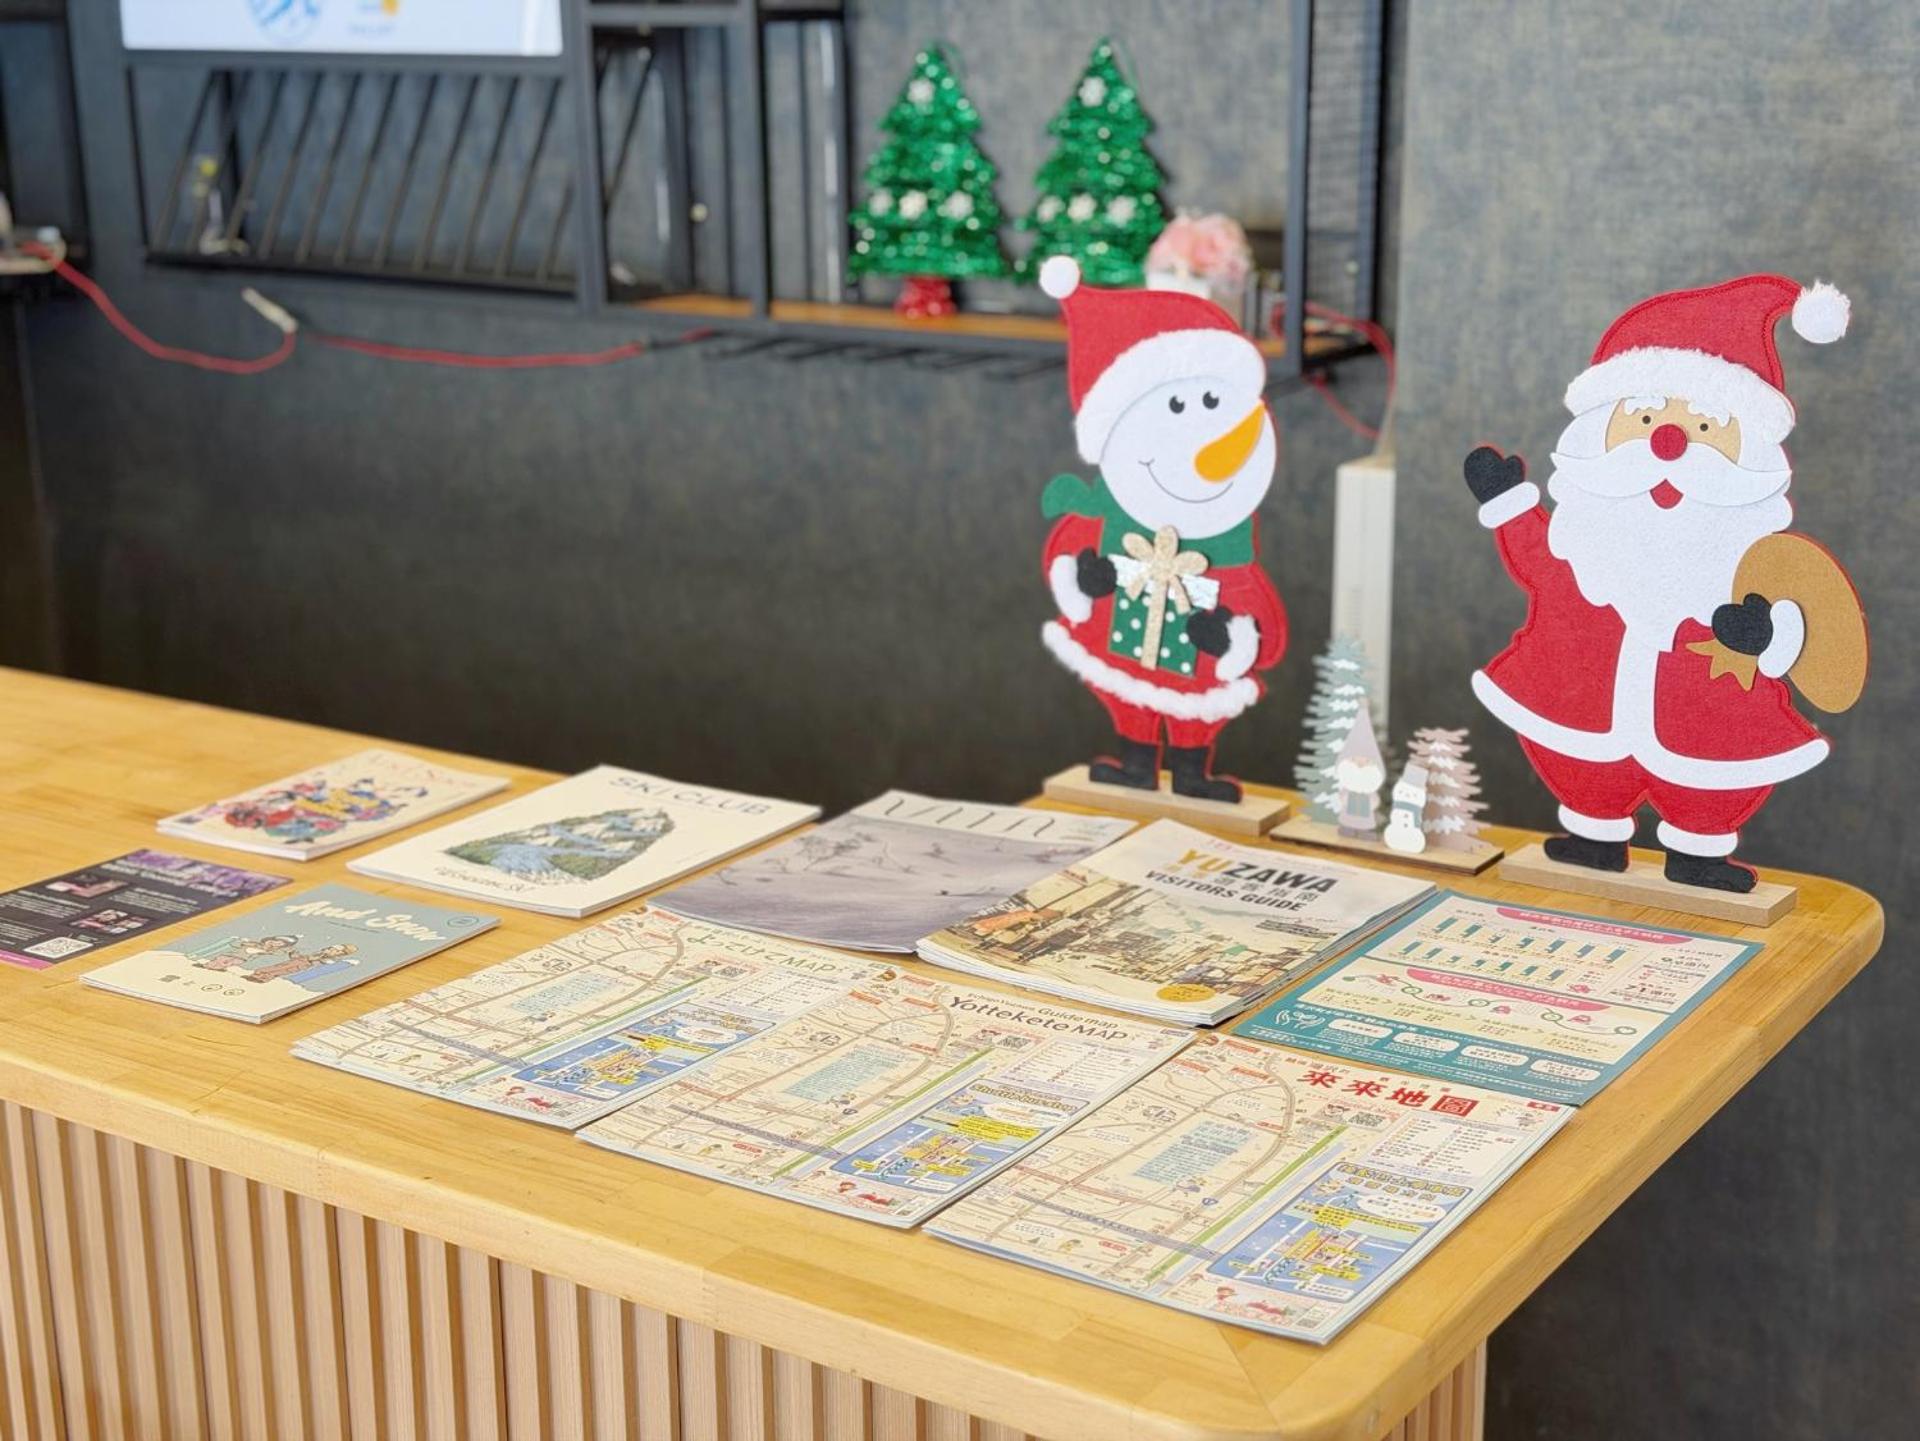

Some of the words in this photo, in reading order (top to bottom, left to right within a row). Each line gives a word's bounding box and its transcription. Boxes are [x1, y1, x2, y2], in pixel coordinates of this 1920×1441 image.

[673, 789, 772, 815] CLUB
[1145, 870, 1240, 899] VISITORS
[1240, 894, 1308, 912] GUIDE
[1177, 849, 1339, 893] YUZAWA
[949, 996, 1070, 1031] Yottekete
[1070, 1024, 1129, 1041] MAP
[1038, 1007, 1083, 1022] Guide
